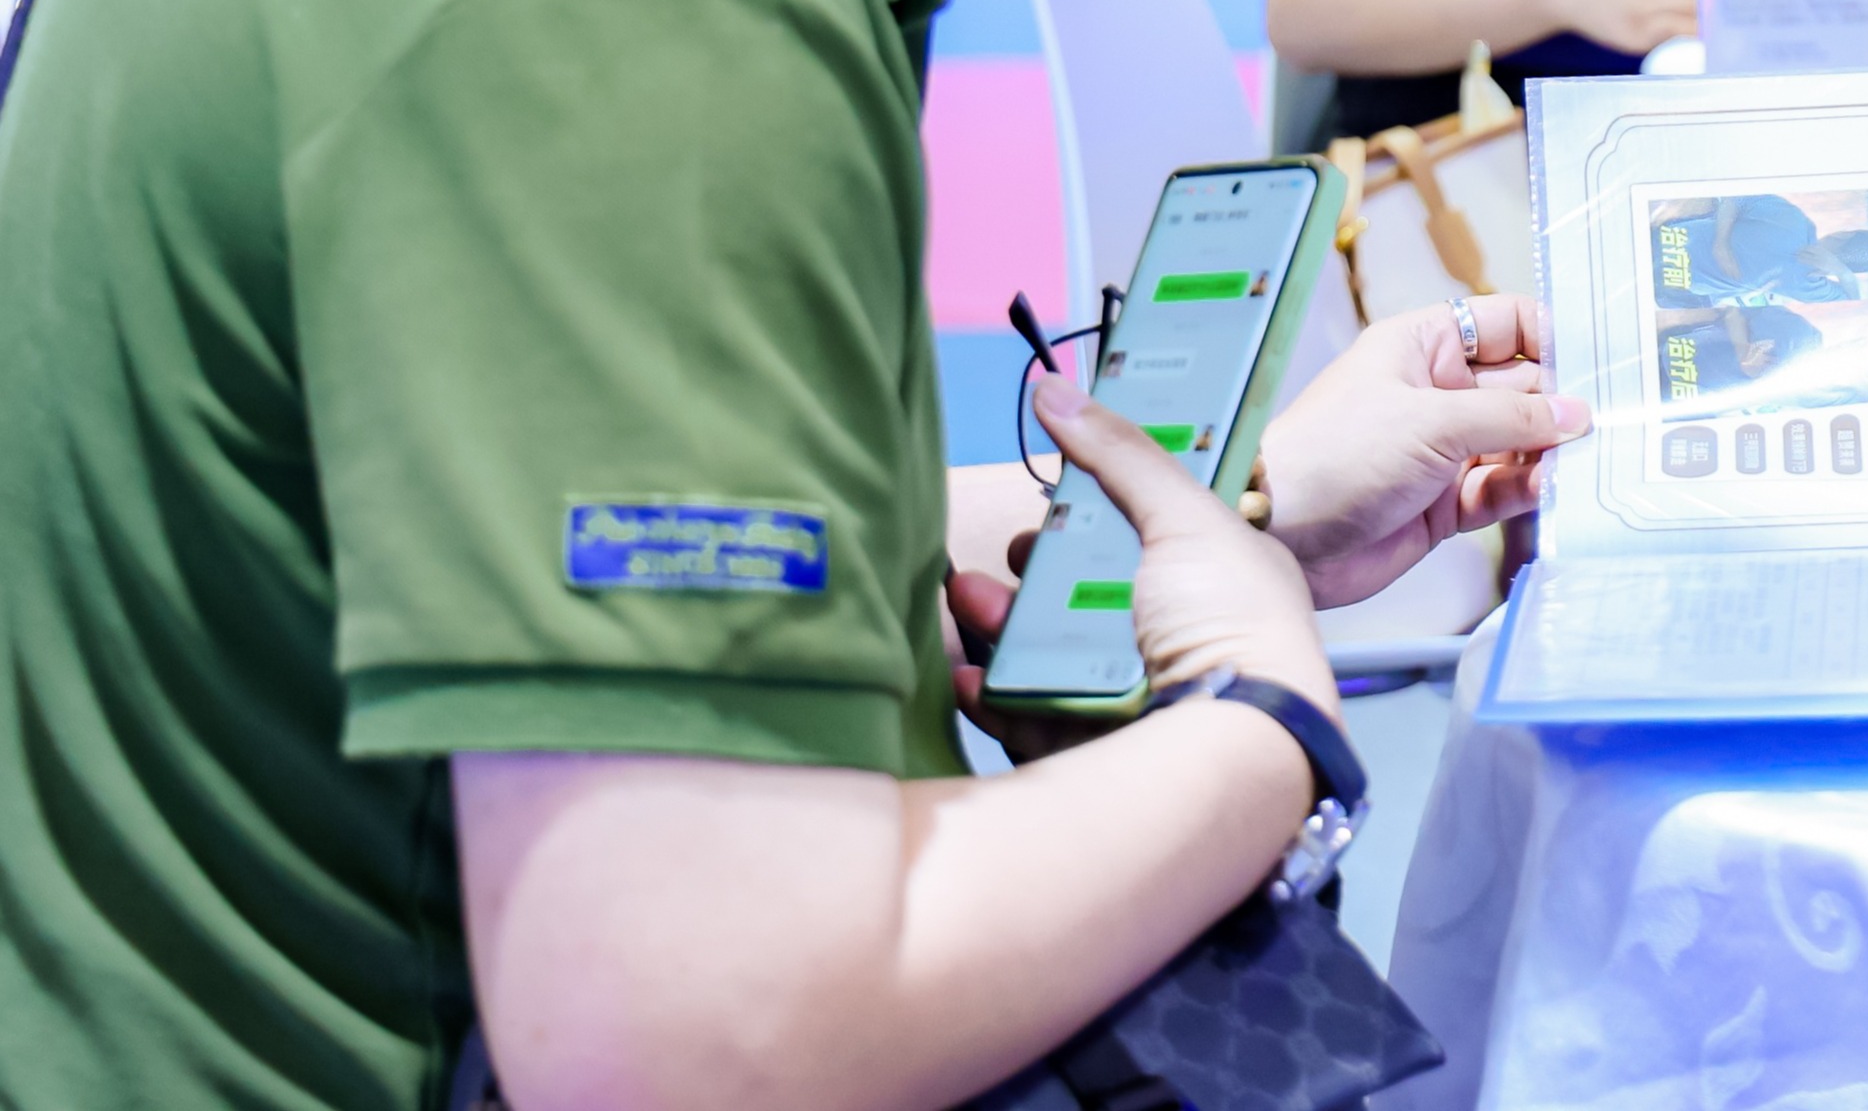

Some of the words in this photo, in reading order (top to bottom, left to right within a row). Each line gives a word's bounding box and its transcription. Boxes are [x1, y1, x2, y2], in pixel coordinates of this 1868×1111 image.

[1660, 225, 1691, 289] 治疗前
[1667, 336, 1698, 400] 治疗后
